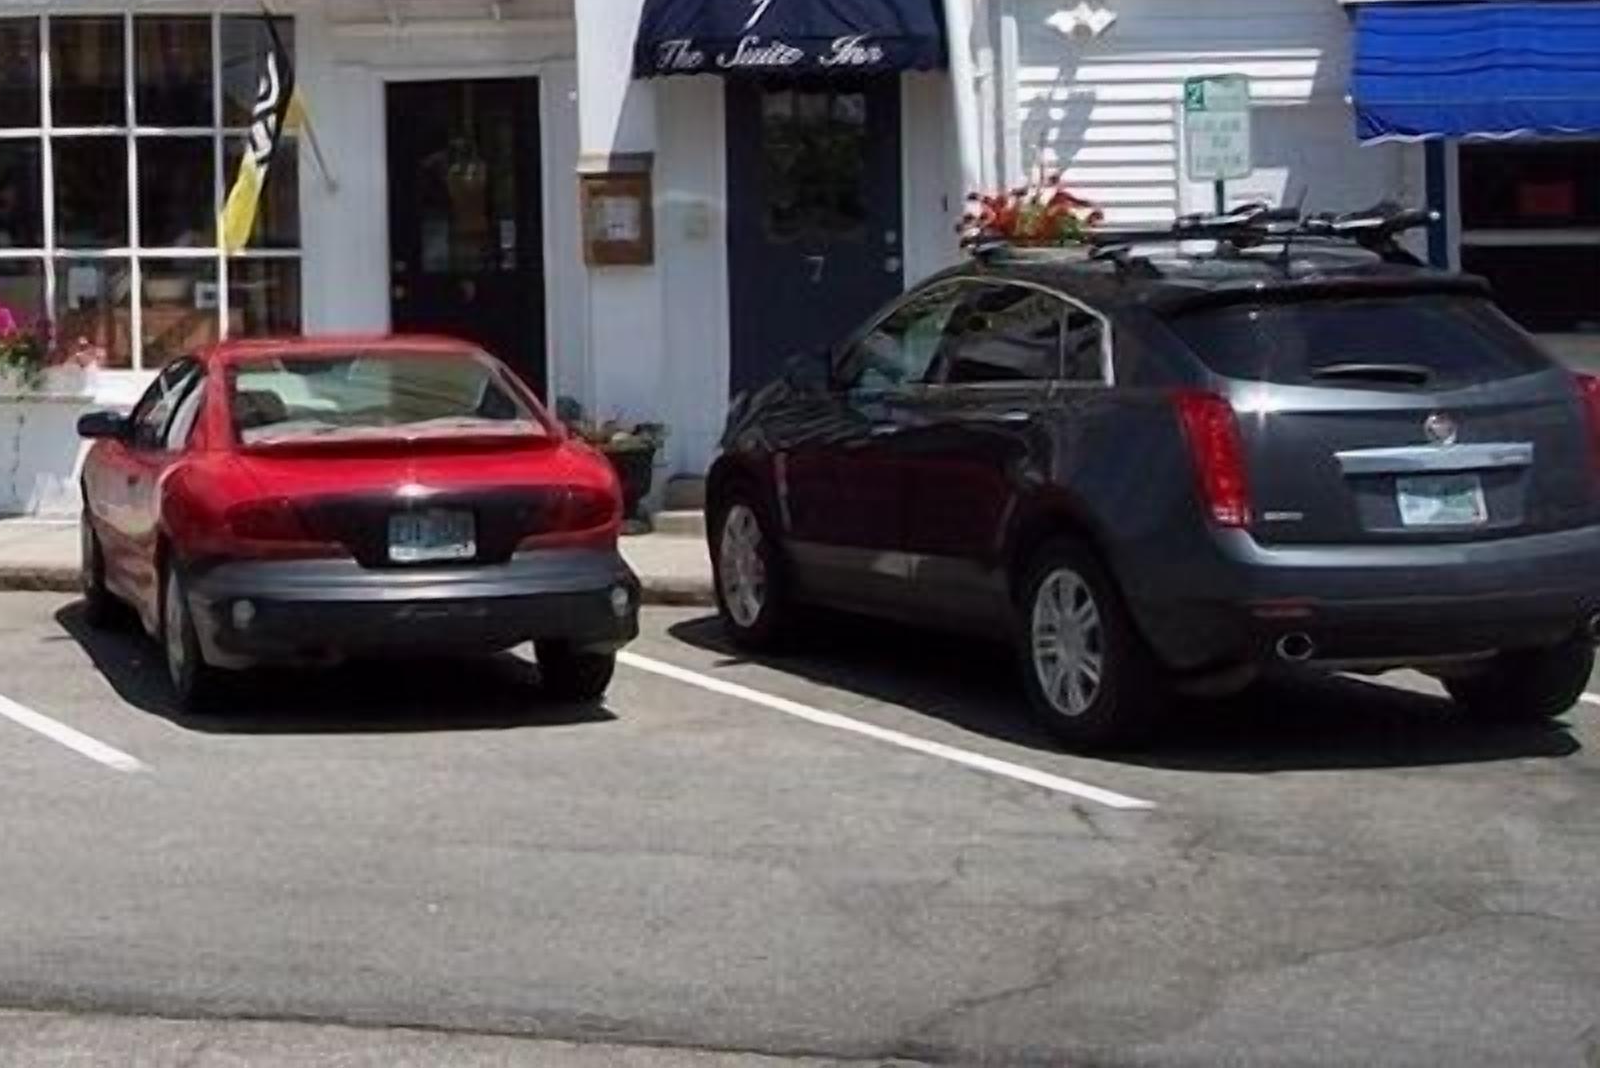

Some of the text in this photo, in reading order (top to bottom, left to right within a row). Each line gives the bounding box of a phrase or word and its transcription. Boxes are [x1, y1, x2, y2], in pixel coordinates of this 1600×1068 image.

[656, 32, 884, 69] The Suite Inn
